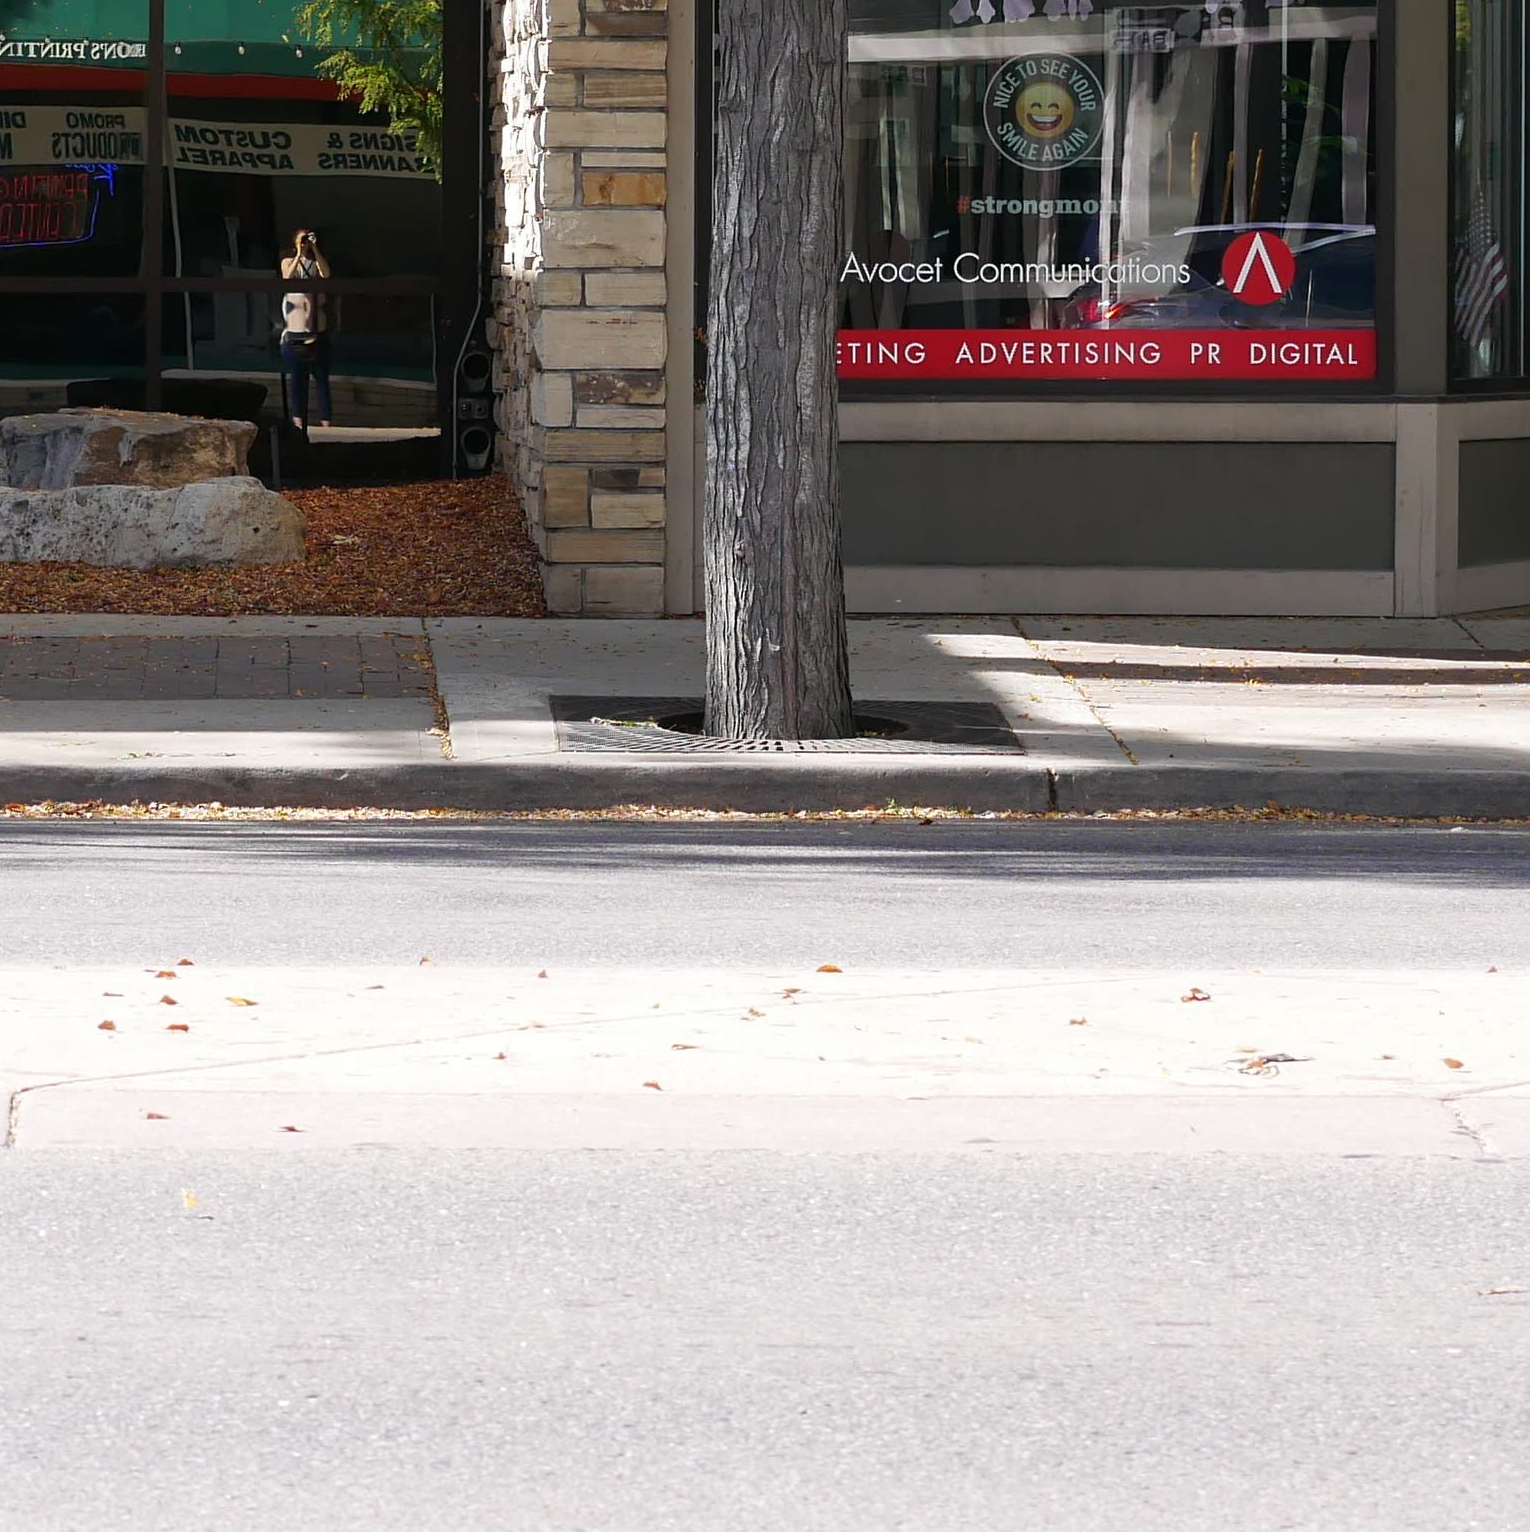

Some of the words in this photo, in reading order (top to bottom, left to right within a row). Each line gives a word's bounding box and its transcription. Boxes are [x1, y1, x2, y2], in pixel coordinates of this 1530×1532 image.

[992, 72, 1021, 108] NICE
[1015, 60, 1038, 79] TO
[1040, 59, 1069, 79] SEE
[1069, 70, 1096, 111] YOUR
[997, 122, 1040, 161] SMILE
[1041, 128, 1089, 162] AGAIN
[840, 252, 943, 283] Avocet
[953, 251, 1191, 284] Communications
[956, 342, 1161, 365] ADVERTISING
[1191, 342, 1222, 365] PR
[1250, 342, 1358, 365] DIGITAL
